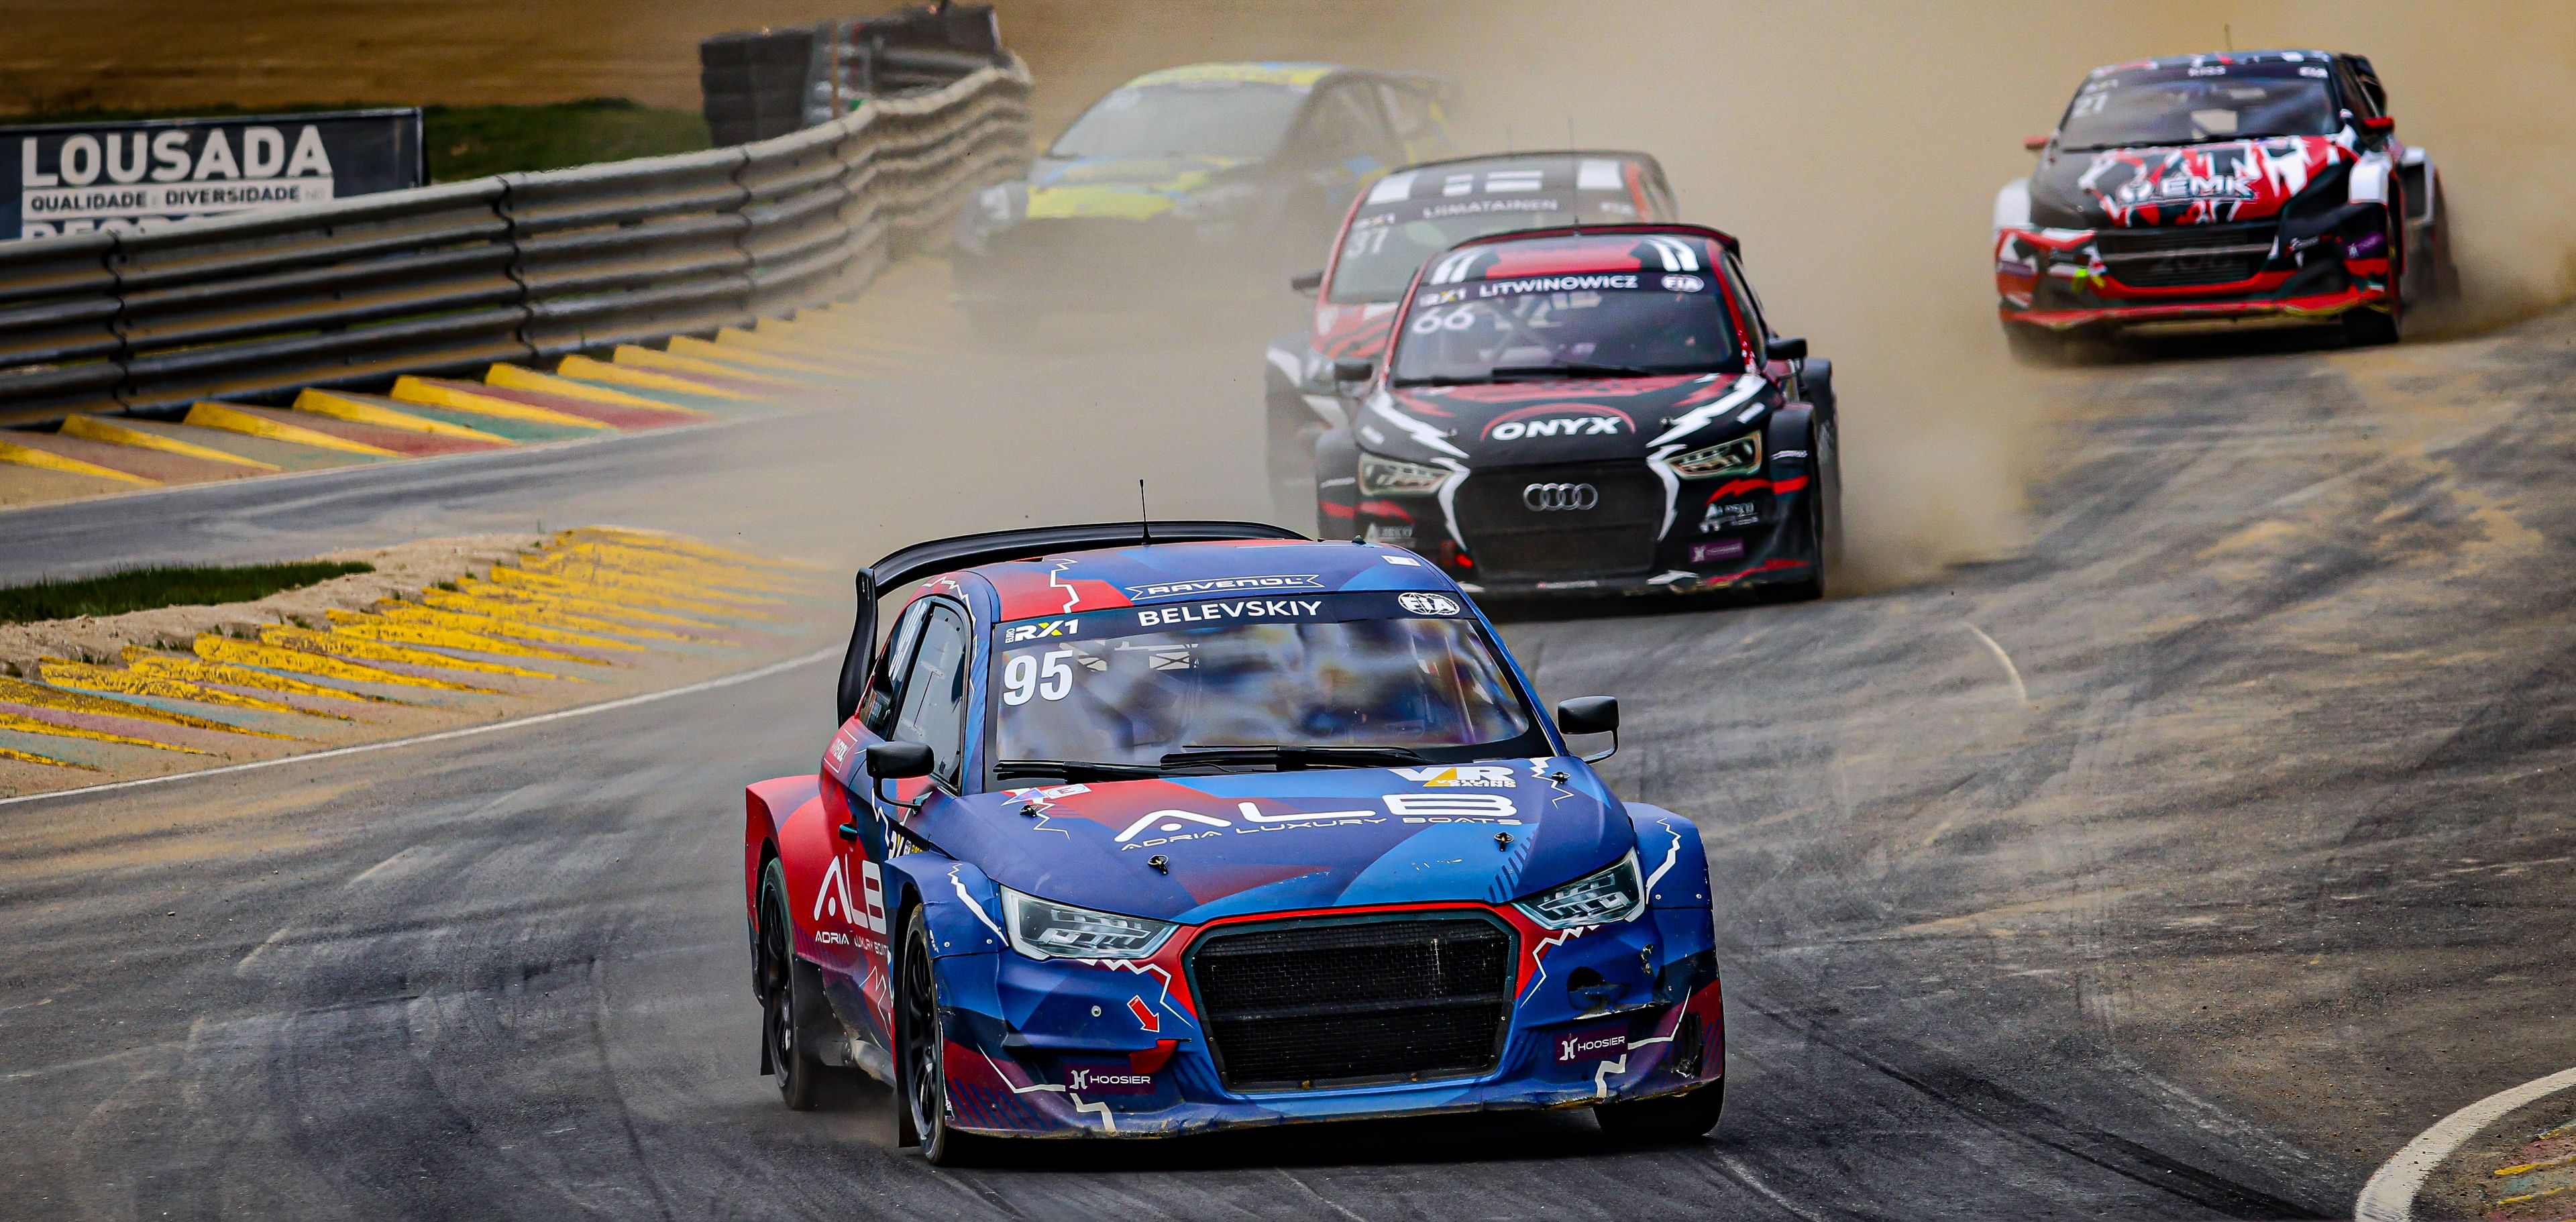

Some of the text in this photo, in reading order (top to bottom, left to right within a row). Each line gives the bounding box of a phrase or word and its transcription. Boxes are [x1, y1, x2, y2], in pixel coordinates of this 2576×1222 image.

[22, 125, 333, 186] LOUSADA
[32, 192, 147, 211] QUALIDADE
[165, 185, 301, 206] DIVERSIDADE
[1422, 199, 1558, 220] LIIMATAINEN
[1479, 275, 1639, 298] LITWINOWICZ
[1411, 304, 1475, 335] 66
[1491, 416, 1623, 441] ONYX
[1147, 577, 1305, 596] RAVENOL
[1137, 600, 1322, 627] BELEVSKIY
[1399, 593, 1460, 615] FIA
[1014, 618, 1079, 642] RX1
[1003, 649, 1073, 706] 95
[1114, 794, 1518, 843] ALB
[1120, 817, 1522, 852] ADRIA LUXURY BOATS
[814, 853, 887, 935] ALB
[815, 930, 850, 945] ADRIA
[1578, 1036, 1625, 1052] HOOSIER
[1090, 1075, 1150, 1084] HOOSIER
